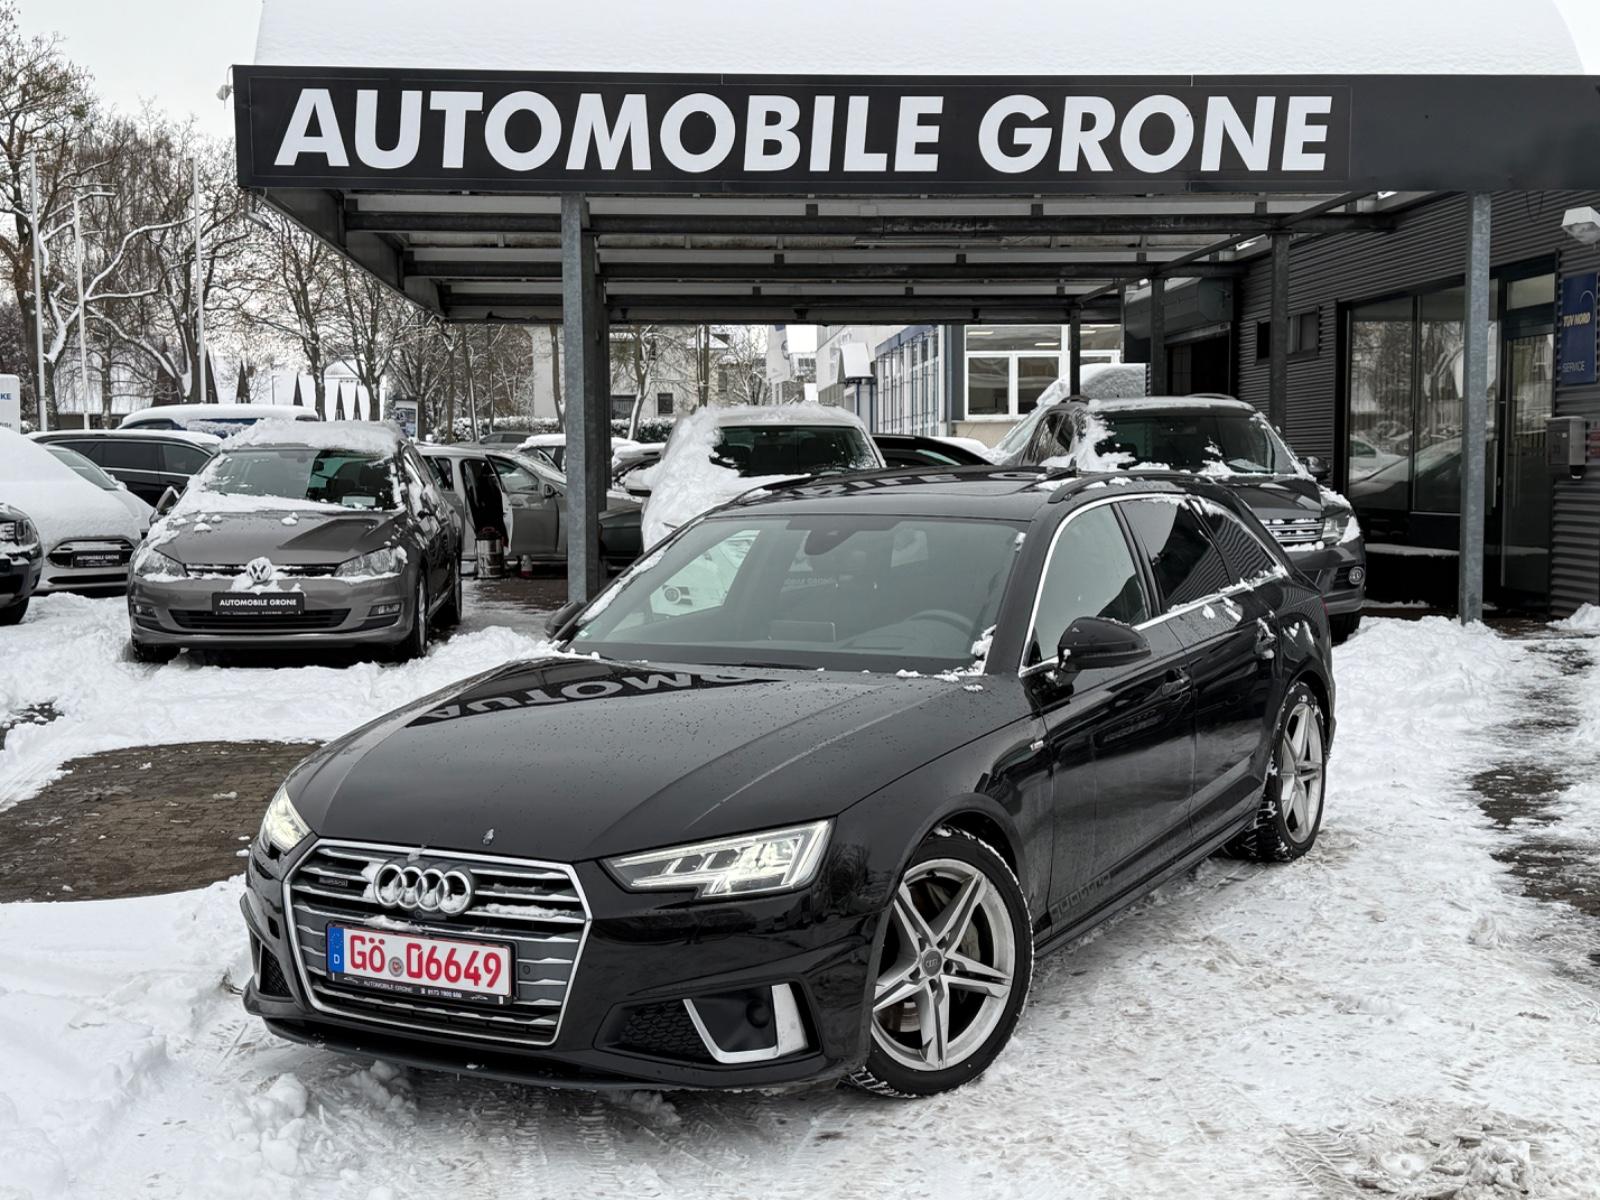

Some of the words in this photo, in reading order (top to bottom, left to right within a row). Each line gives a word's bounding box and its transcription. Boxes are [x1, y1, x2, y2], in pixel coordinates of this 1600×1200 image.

[275, 88, 943, 173] AUTOMOBILE
[979, 94, 1332, 174] GRONE
[333, 953, 341, 965] D
[350, 934, 386, 973] GÖ
